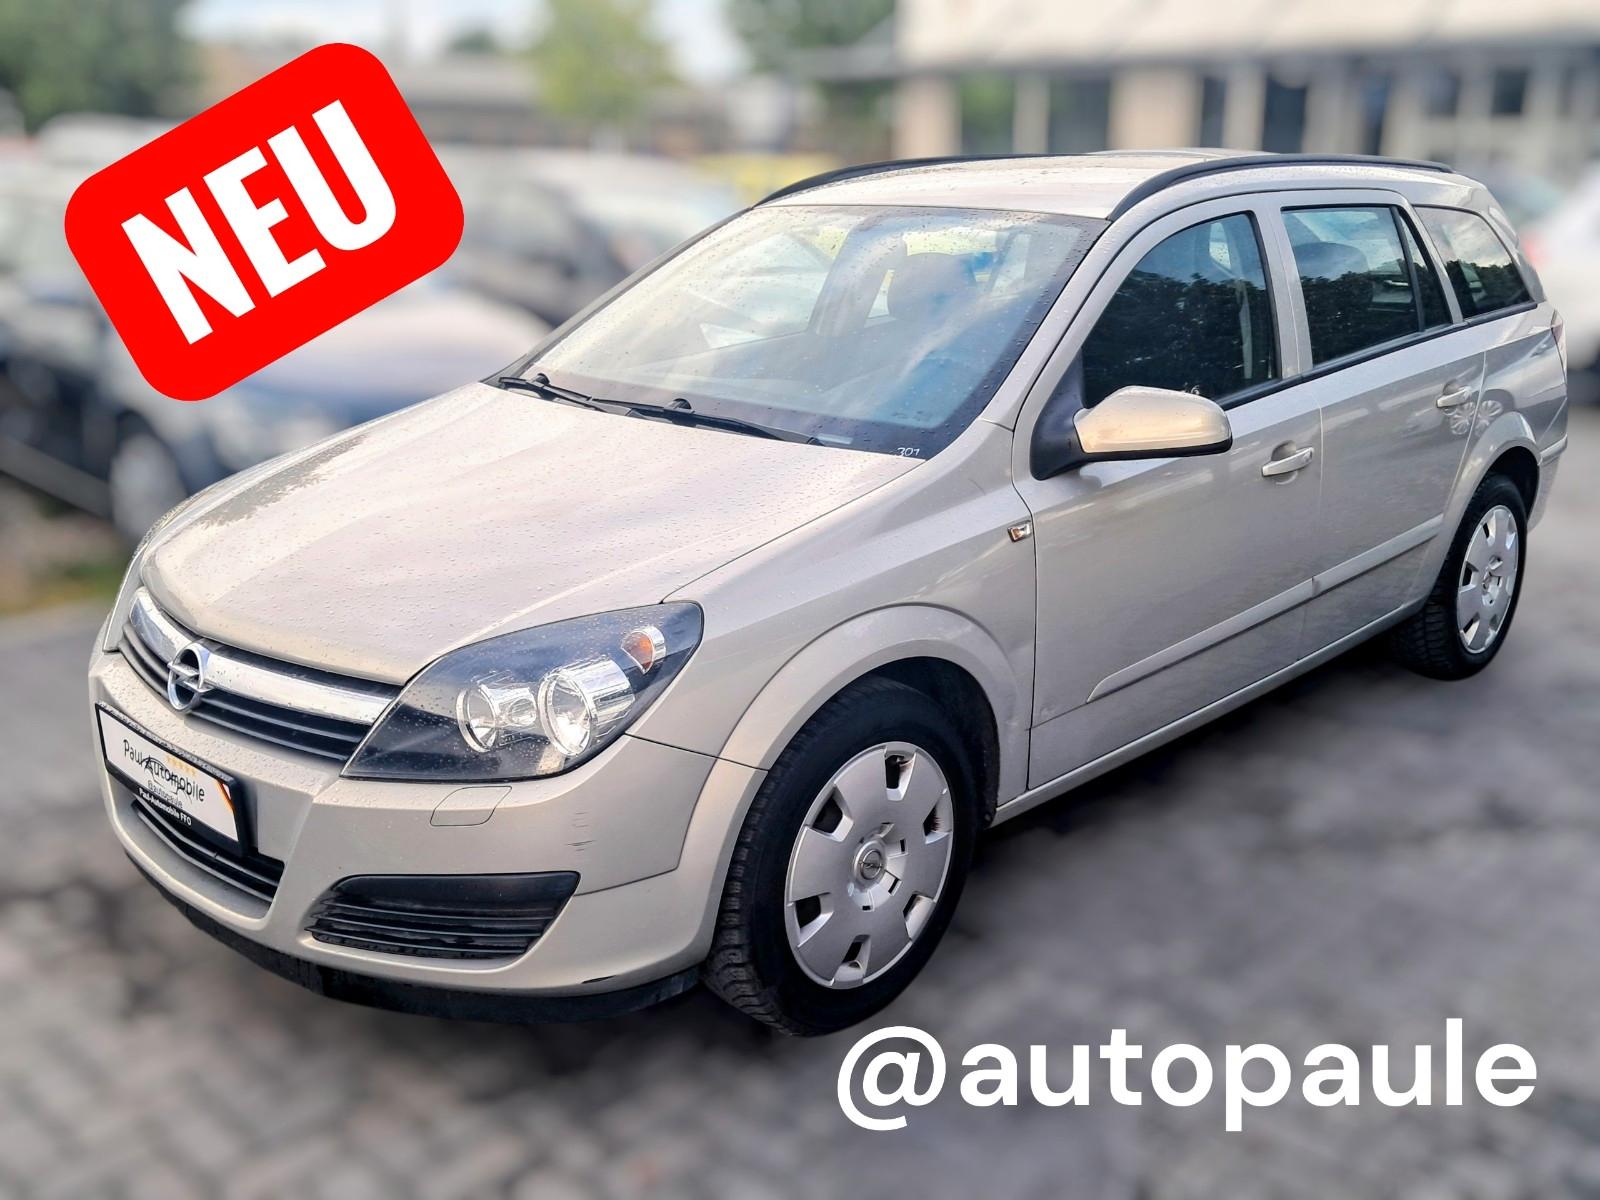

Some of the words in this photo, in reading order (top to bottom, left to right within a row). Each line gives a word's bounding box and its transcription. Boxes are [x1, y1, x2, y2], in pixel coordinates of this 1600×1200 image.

[123, 739, 144, 767] Paul
[144, 755, 205, 803] Automobile
[180, 813, 192, 826] FFO
